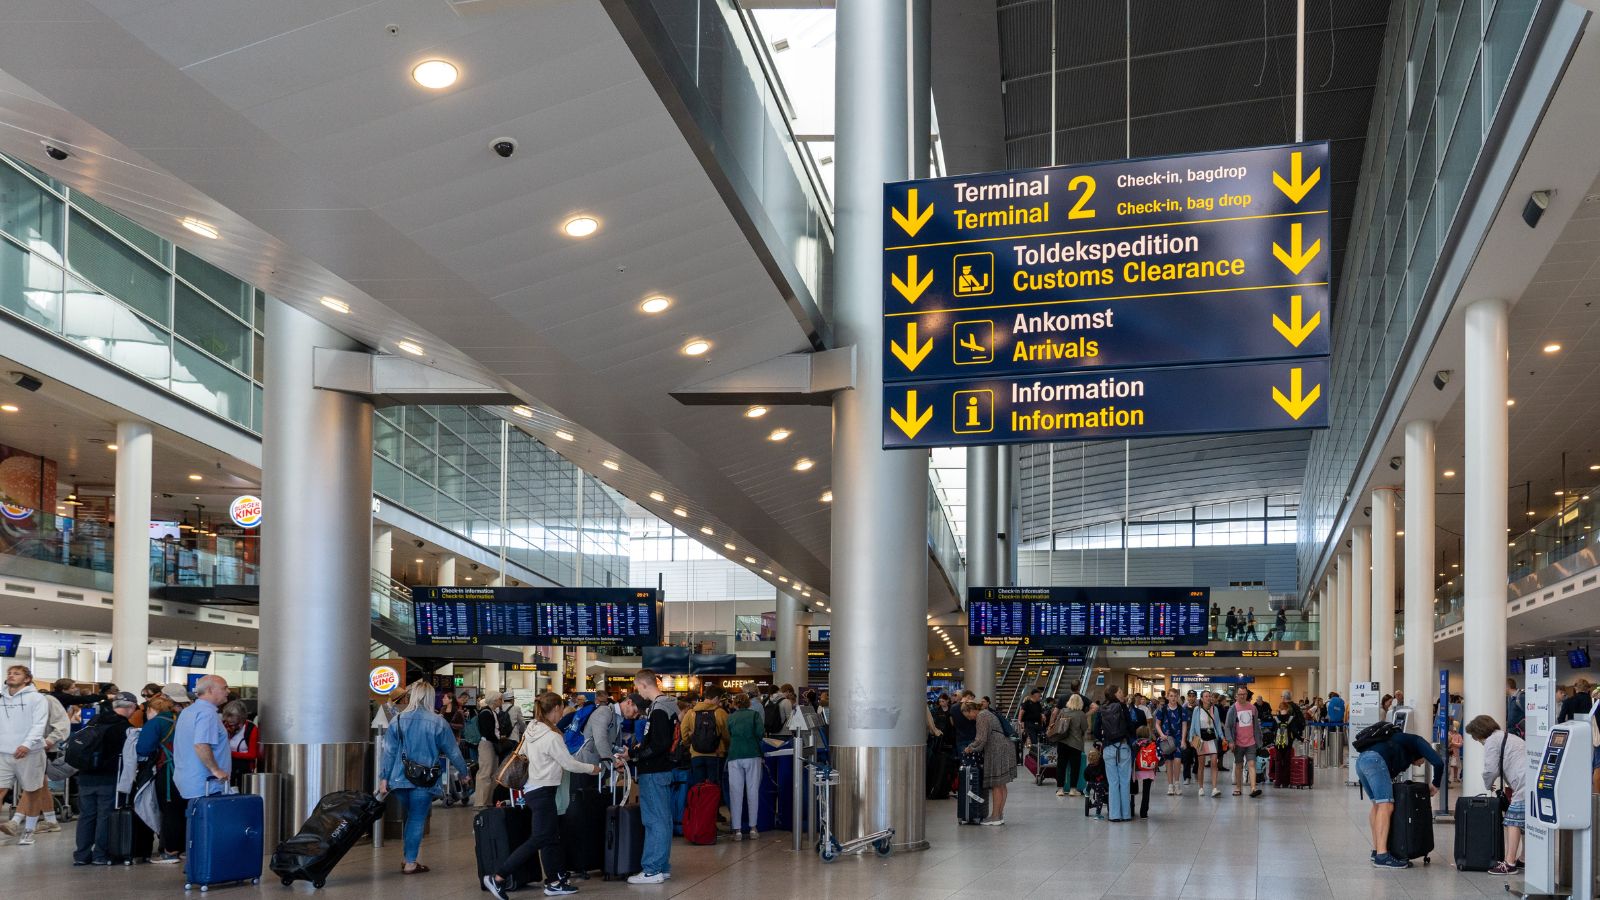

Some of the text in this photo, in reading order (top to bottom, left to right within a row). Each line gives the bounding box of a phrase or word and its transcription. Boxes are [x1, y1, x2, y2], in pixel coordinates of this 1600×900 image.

[954, 174, 1049, 203] Terminal
[1117, 165, 1247, 188] Check-in, bagdrop
[1067, 175, 1097, 220] 2
[1117, 192, 1252, 216] Check-in, bag drop
[954, 201, 1049, 229] Terminal
[1014, 234, 1199, 265] Toldekspedition
[1013, 259, 1245, 292] Customs Clearance
[1013, 309, 1114, 333] Ankomst
[1013, 337, 1099, 361] Arrivals
[1013, 378, 1144, 403] Information
[1012, 407, 1144, 432] Information
[234, 502, 260, 513] BURGER
[235, 507, 261, 519] KING
[472, 636, 478, 644] 3
[1024, 637, 1030, 645] 3
[372, 672, 394, 681] BURGER
[373, 676, 395, 687] KING
[722, 679, 755, 688] CAFFE
